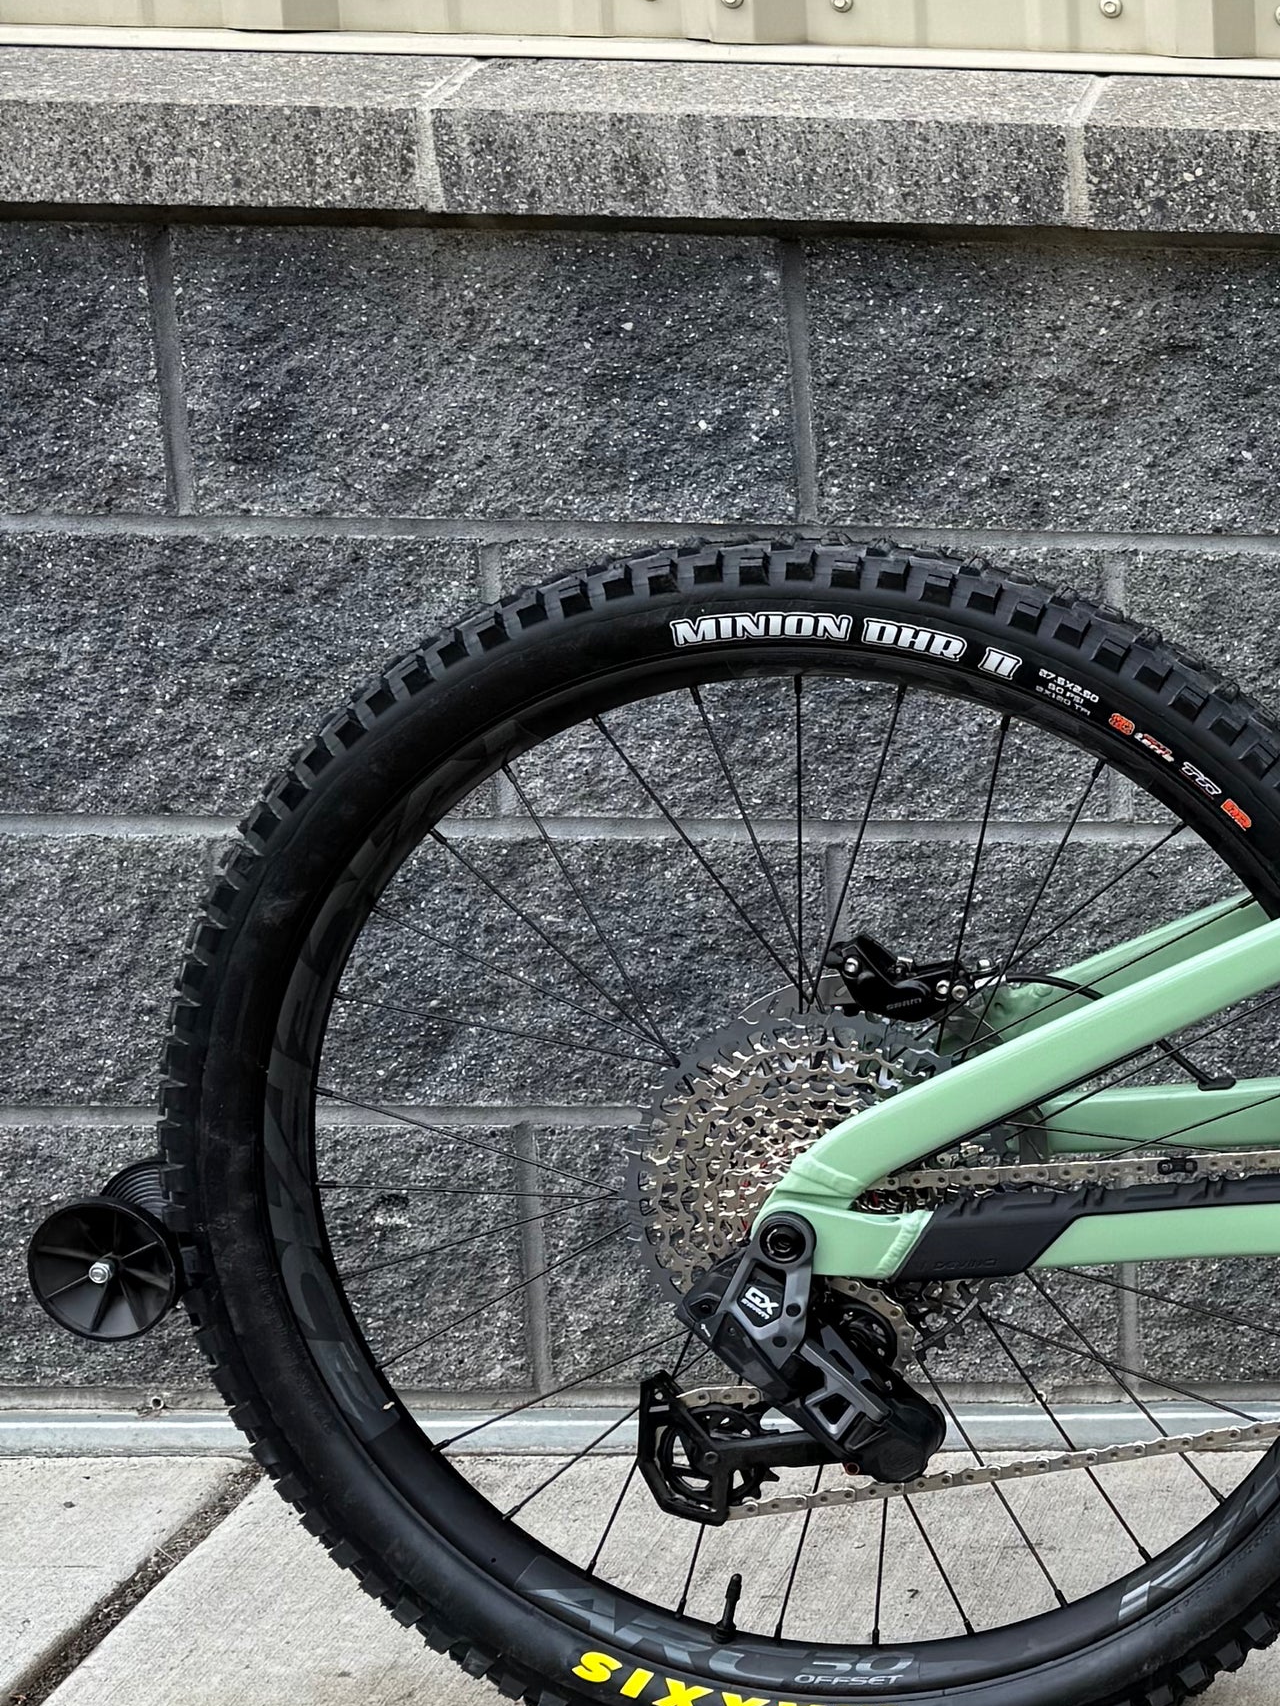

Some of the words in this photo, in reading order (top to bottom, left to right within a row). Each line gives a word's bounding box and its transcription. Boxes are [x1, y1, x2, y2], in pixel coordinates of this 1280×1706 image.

[669, 612, 852, 647] MINION
[861, 617, 967, 662] DHR
[978, 647, 1023, 680] II
[744, 1286, 781, 1313] GX
[793, 1673, 905, 1687] OFFSET
